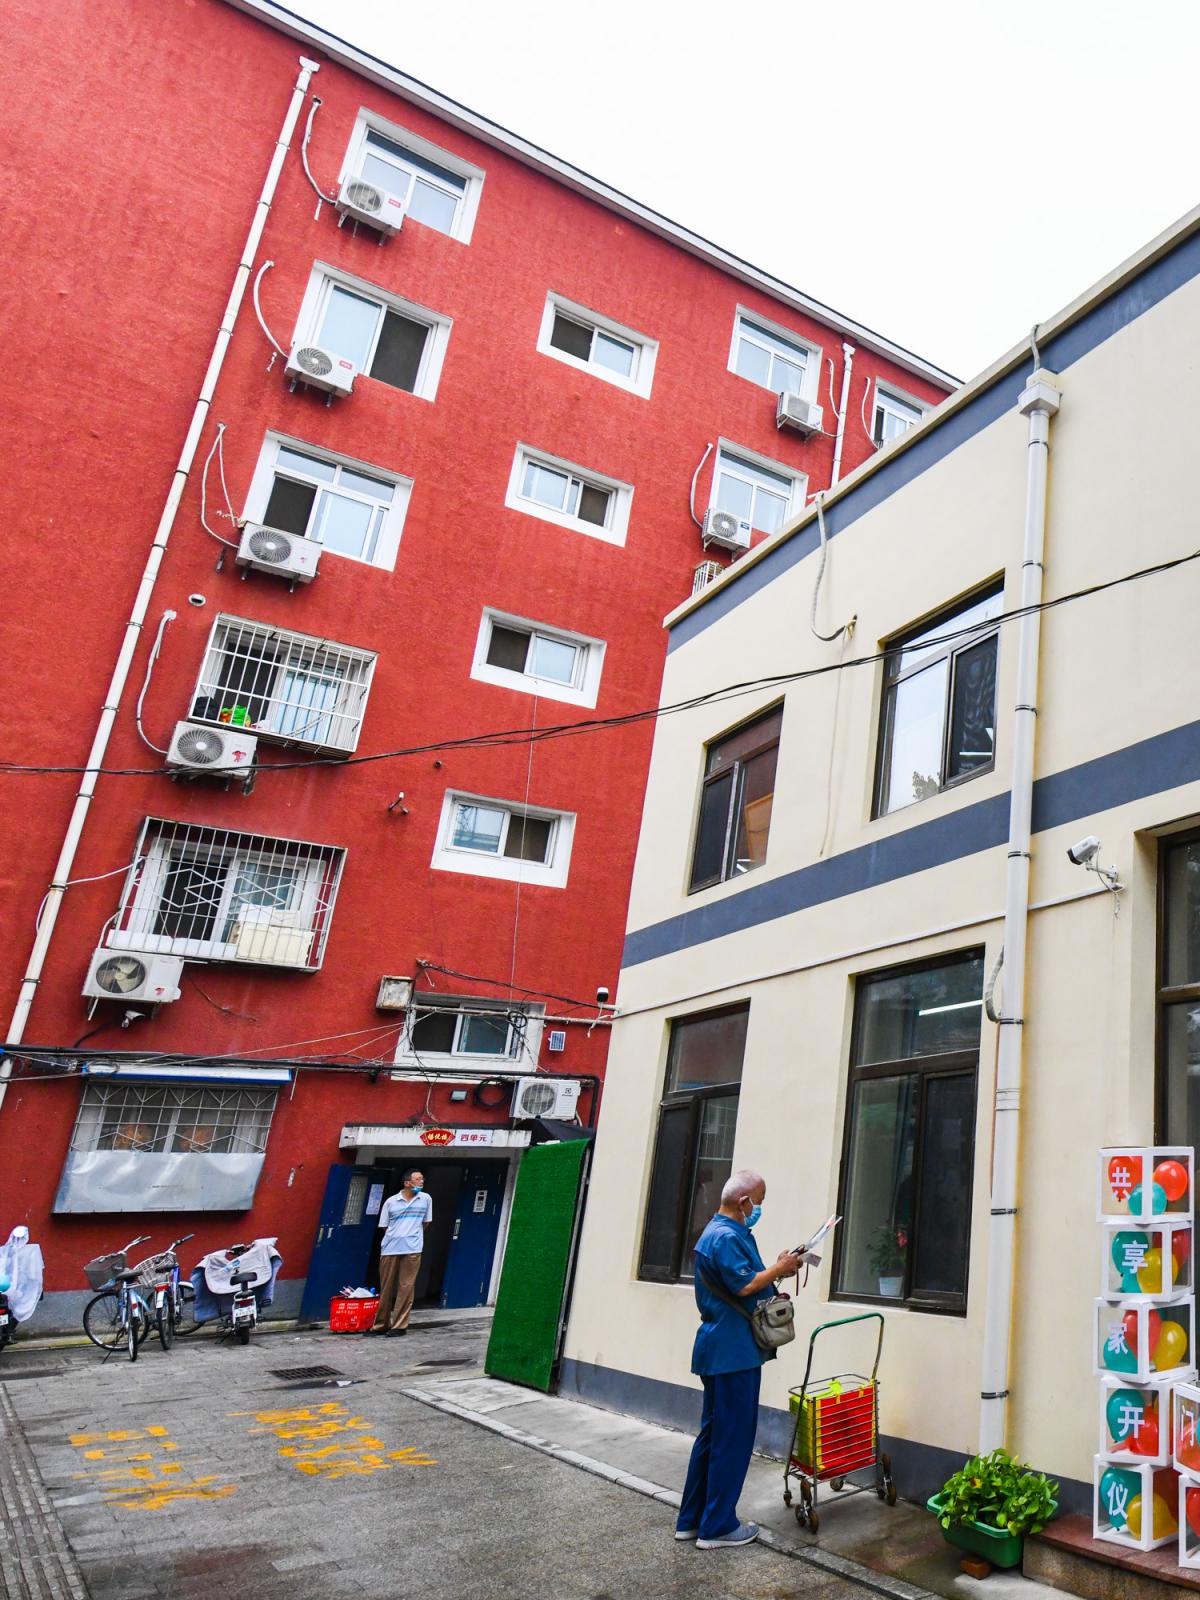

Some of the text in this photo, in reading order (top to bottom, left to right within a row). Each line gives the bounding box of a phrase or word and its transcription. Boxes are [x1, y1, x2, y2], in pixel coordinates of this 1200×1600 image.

[460, 1134, 487, 1142] 四单元
[1117, 1406, 1146, 1439] 开
[1180, 1405, 1195, 1447] 门
[1106, 1481, 1128, 1520] 仪
